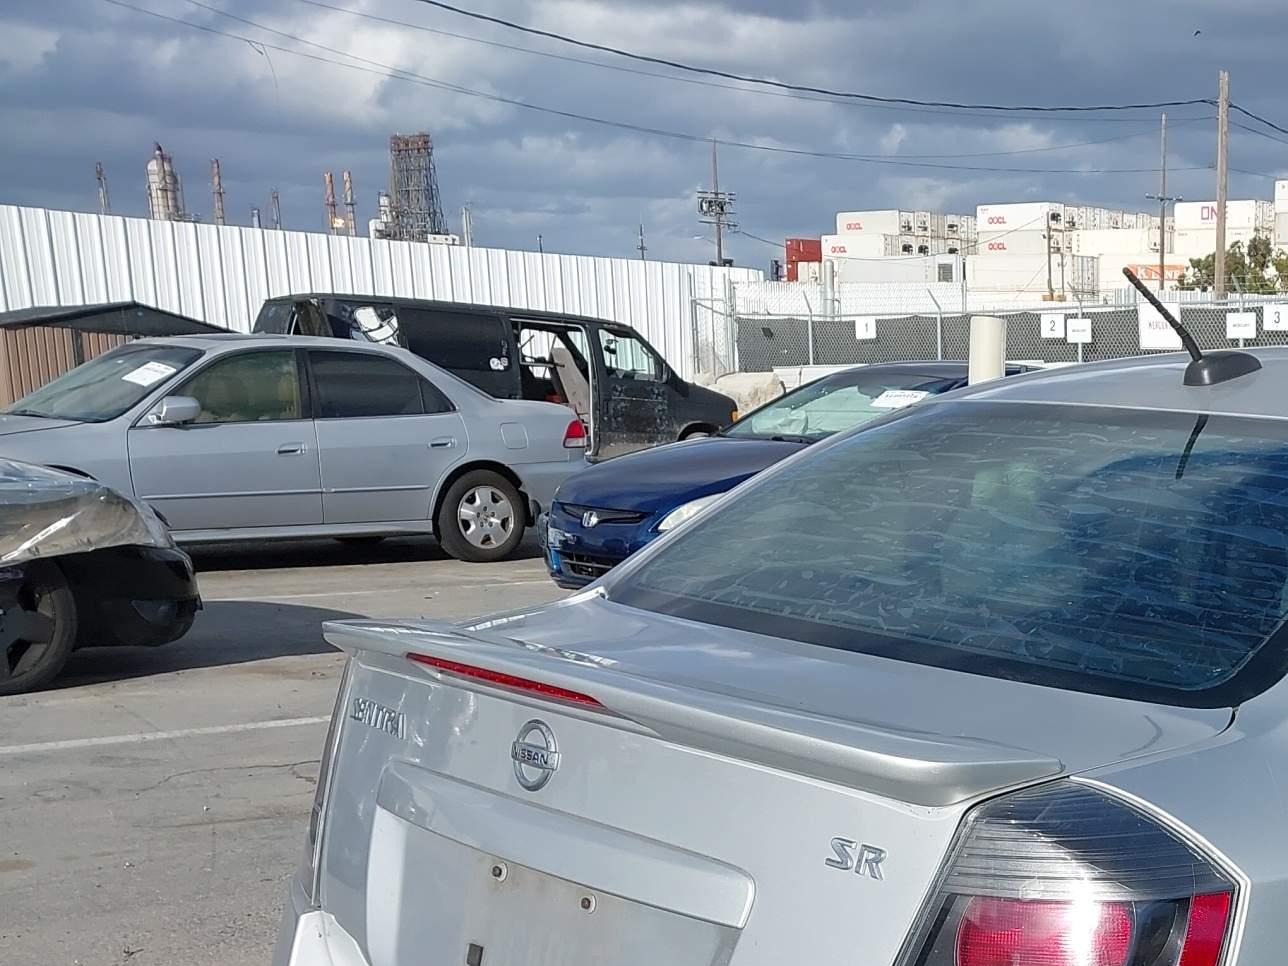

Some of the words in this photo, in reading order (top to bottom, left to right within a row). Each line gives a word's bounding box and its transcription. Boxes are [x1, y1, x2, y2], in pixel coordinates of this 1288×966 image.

[987, 215, 1007, 225] OOCL
[1201, 205, 1228, 221] ON
[845, 222, 863, 231] OOCL
[987, 241, 1007, 251] OOCL
[1274, 309, 1281, 324] 3
[1049, 319, 1056, 332] 2
[512, 743, 549, 766] NISSAN
[825, 837, 887, 881] SR
